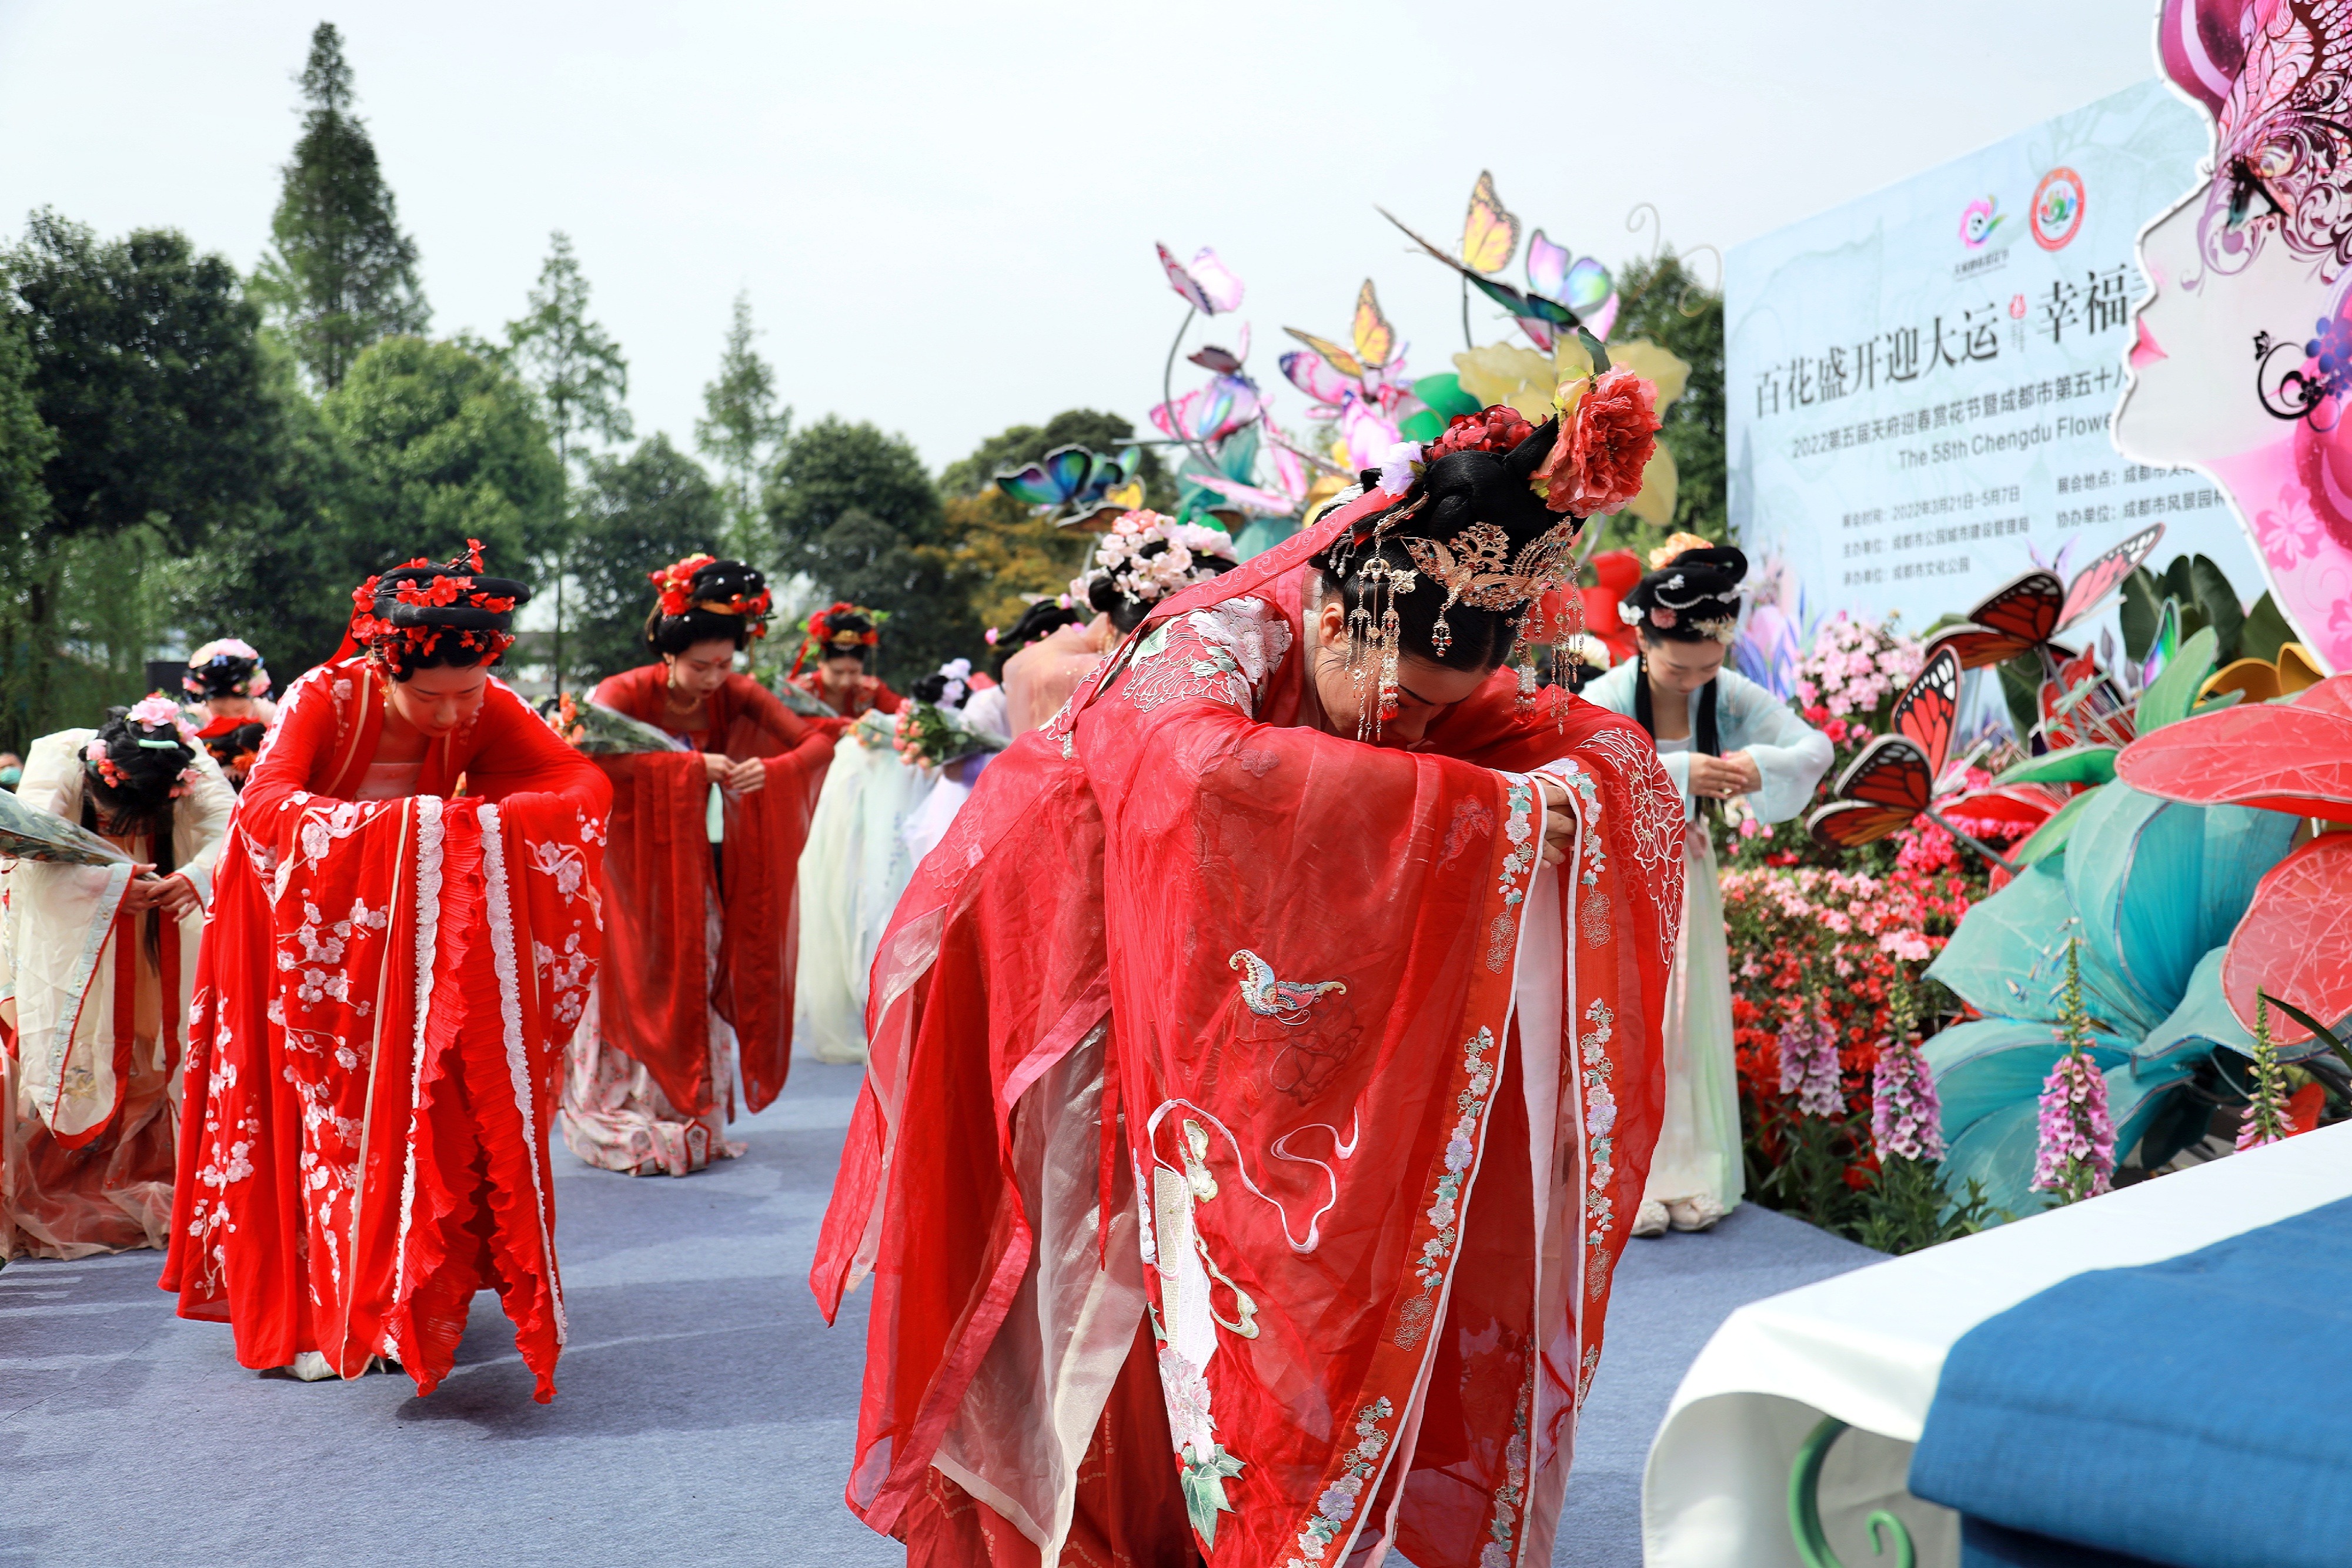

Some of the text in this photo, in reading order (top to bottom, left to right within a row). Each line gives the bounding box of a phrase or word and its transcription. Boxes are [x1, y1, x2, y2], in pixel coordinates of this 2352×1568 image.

[1753, 262, 2148, 418] 百花盛开迎大运 幸福
[1899, 449, 1928, 470] The
[1932, 440, 1968, 463] 58th
[1972, 422, 2052, 455] Chengdu
